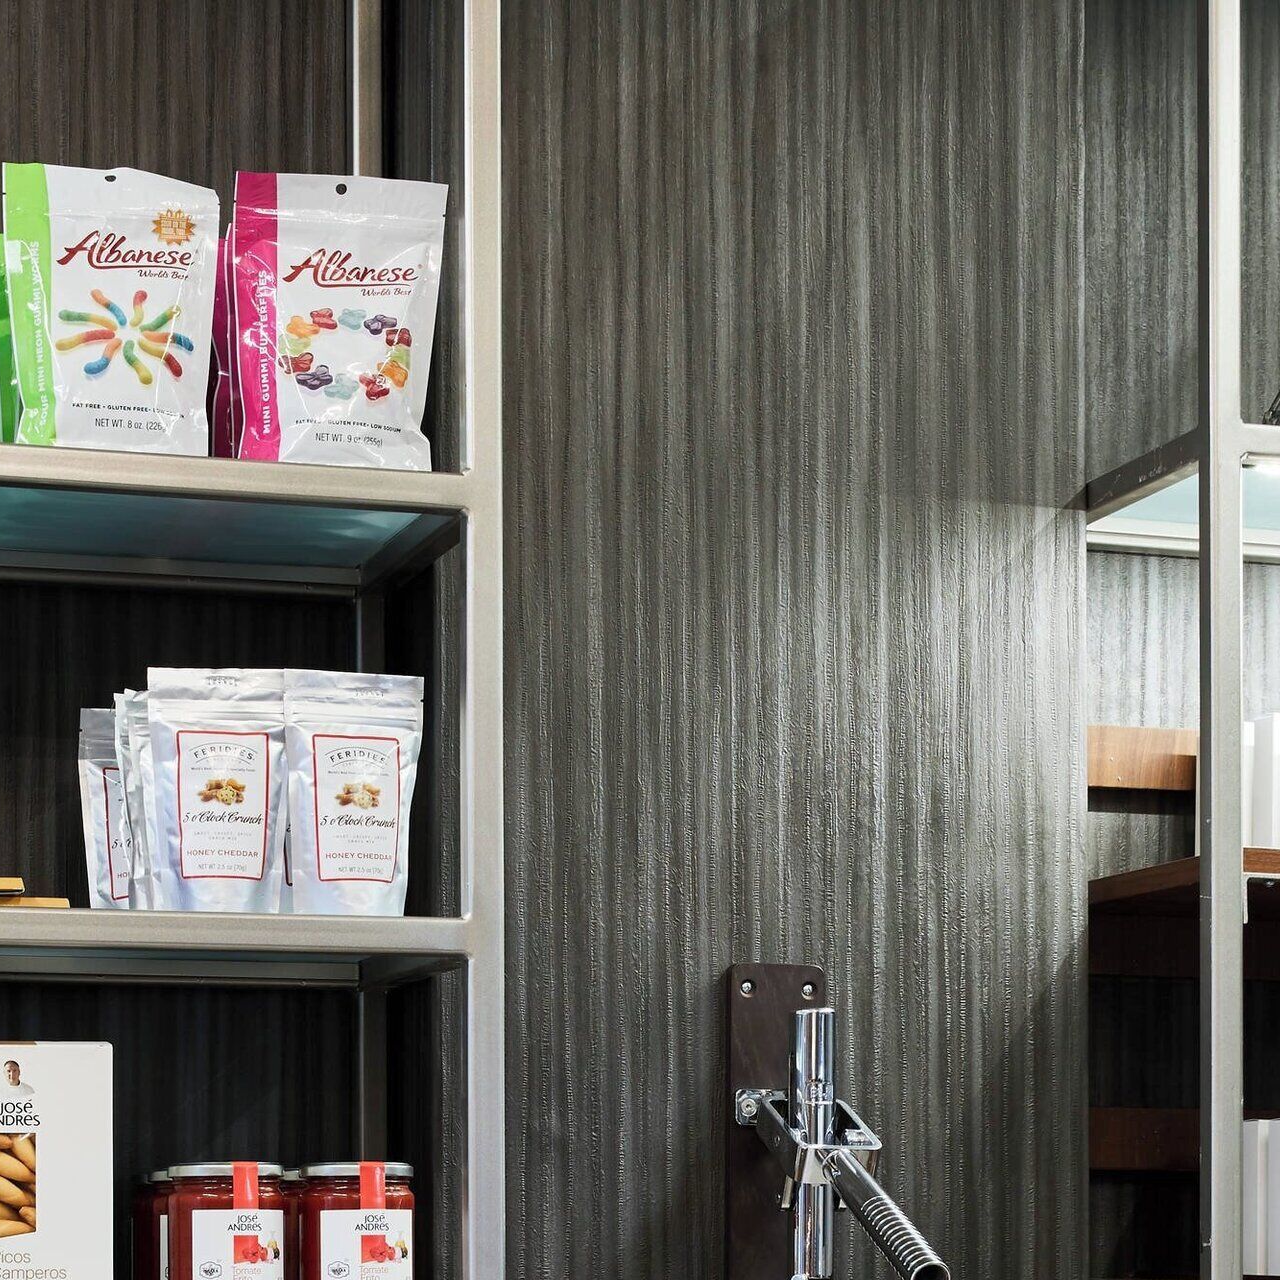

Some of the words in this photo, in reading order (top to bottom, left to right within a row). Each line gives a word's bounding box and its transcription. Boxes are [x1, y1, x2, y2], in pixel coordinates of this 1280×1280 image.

[56, 230, 194, 269] Albanese
[282, 248, 419, 287] Albanese
[35, 334, 45, 364] NEON
[37, 368, 46, 392] MINI
[261, 358, 270, 400] GUMMI
[107, 404, 131, 412] GLUTEN
[95, 418, 109, 428] NET
[127, 419, 133, 428] 8
[315, 433, 329, 443] NET
[347, 434, 353, 443] 9
[183, 812, 190, 824] 5
[228, 811, 263, 825] Crunch
[320, 816, 328, 827] 5
[363, 815, 395, 829] Crunch
[218, 850, 259, 858] CHEDDAR
